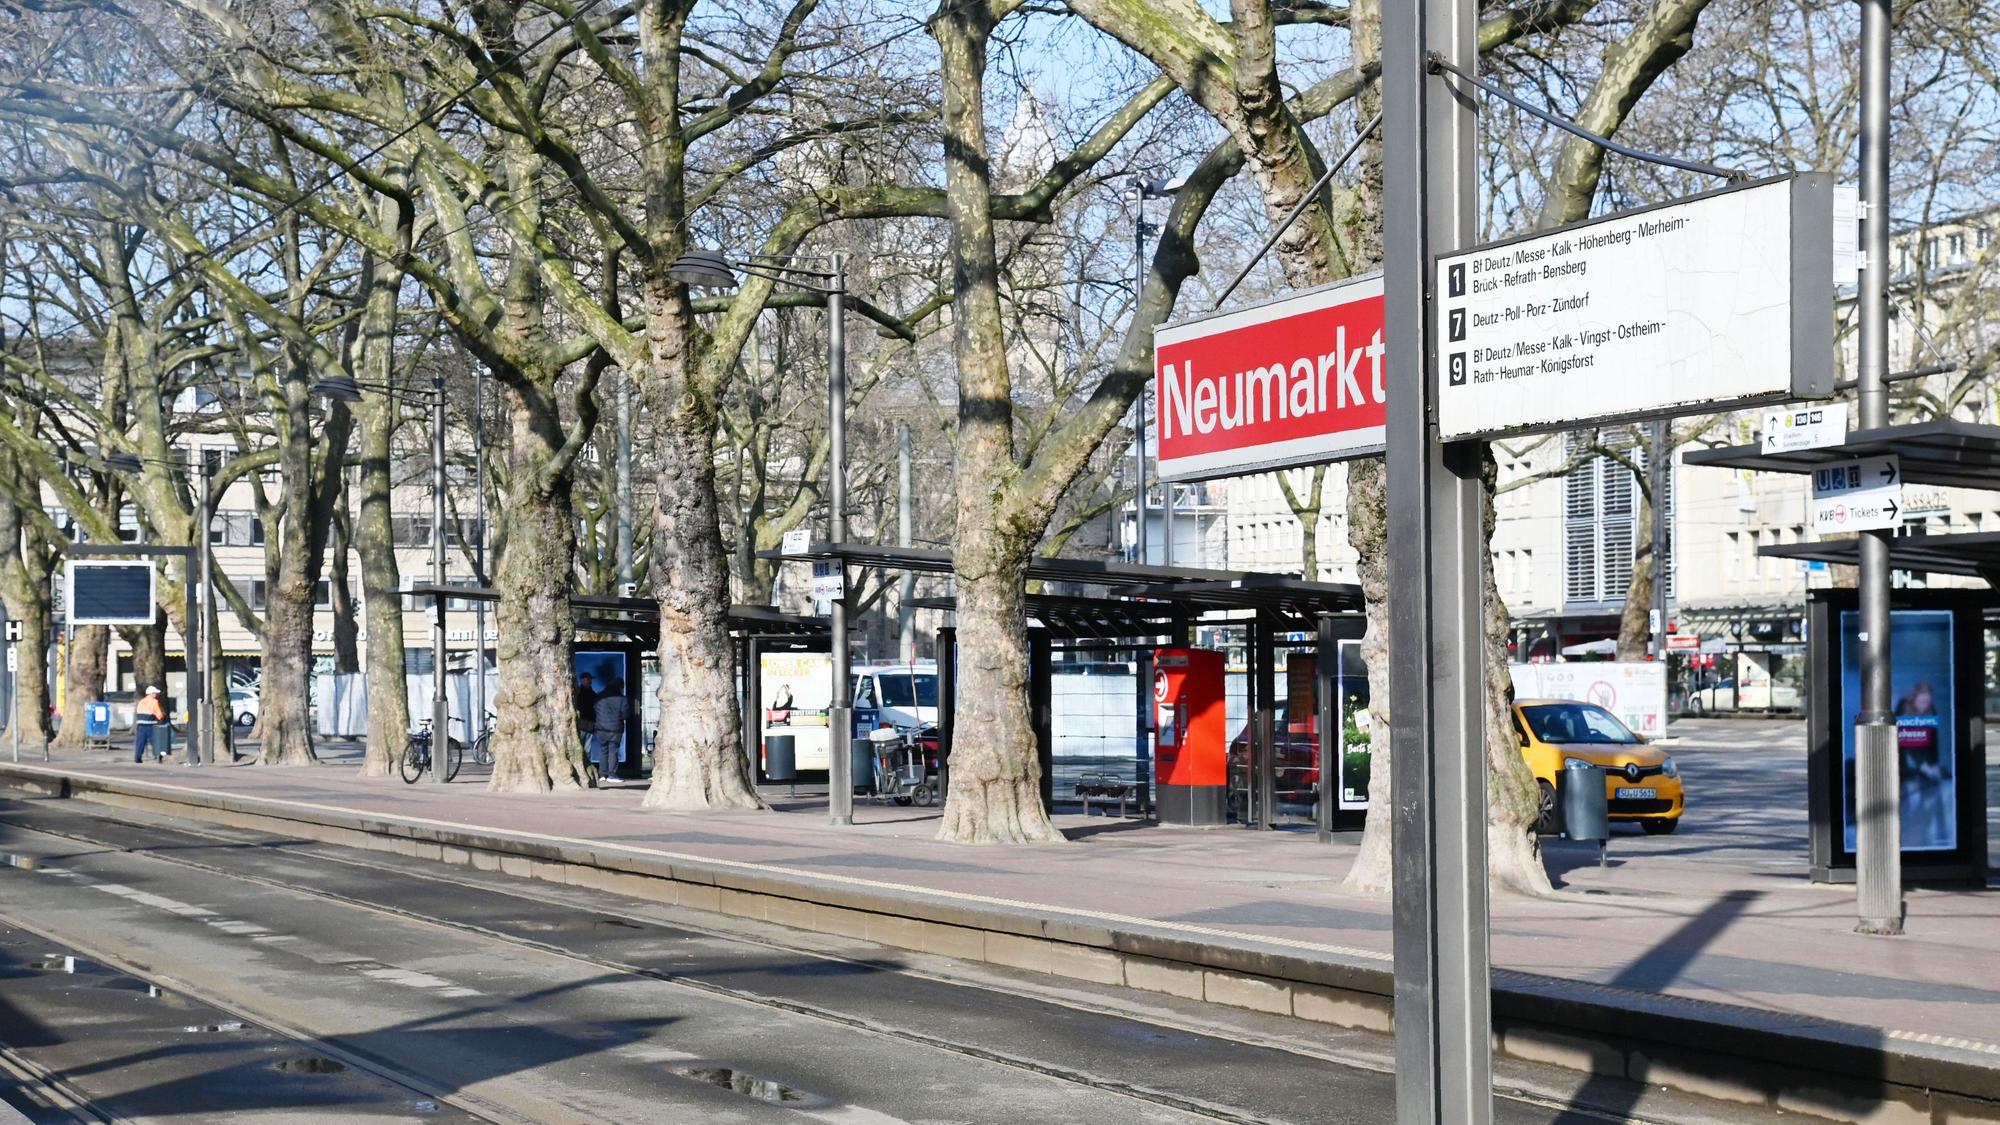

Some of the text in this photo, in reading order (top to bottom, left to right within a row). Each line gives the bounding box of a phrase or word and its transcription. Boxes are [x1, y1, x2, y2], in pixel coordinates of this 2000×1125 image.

[1473, 259, 1483, 273] Bf
[1485, 250, 1545, 271] Deutz/Messe
[1552, 240, 1572, 257] Kalk
[1579, 230, 1631, 251] Höhenberg
[1473, 277, 1498, 293] Brück
[1504, 268, 1537, 287] Refrath
[1543, 261, 1587, 279] Bensberg
[1473, 313, 1499, 327] Deutz
[1505, 305, 1521, 321] Poll
[1526, 303, 1546, 317] Porz
[1552, 291, 1590, 312] Zündorf
[1473, 349, 1483, 363] Bf
[1485, 341, 1546, 361] Deutz/Messe
[1552, 334, 1572, 350] Kalk
[1579, 329, 1611, 347] Vingst
[1163, 325, 1386, 440] Neumarkt
[1473, 368, 1494, 384] Rath
[1500, 366, 1535, 380] Heumar
[1541, 354, 1594, 374] Königsforst
[1850, 506, 1879, 519] Tickets
